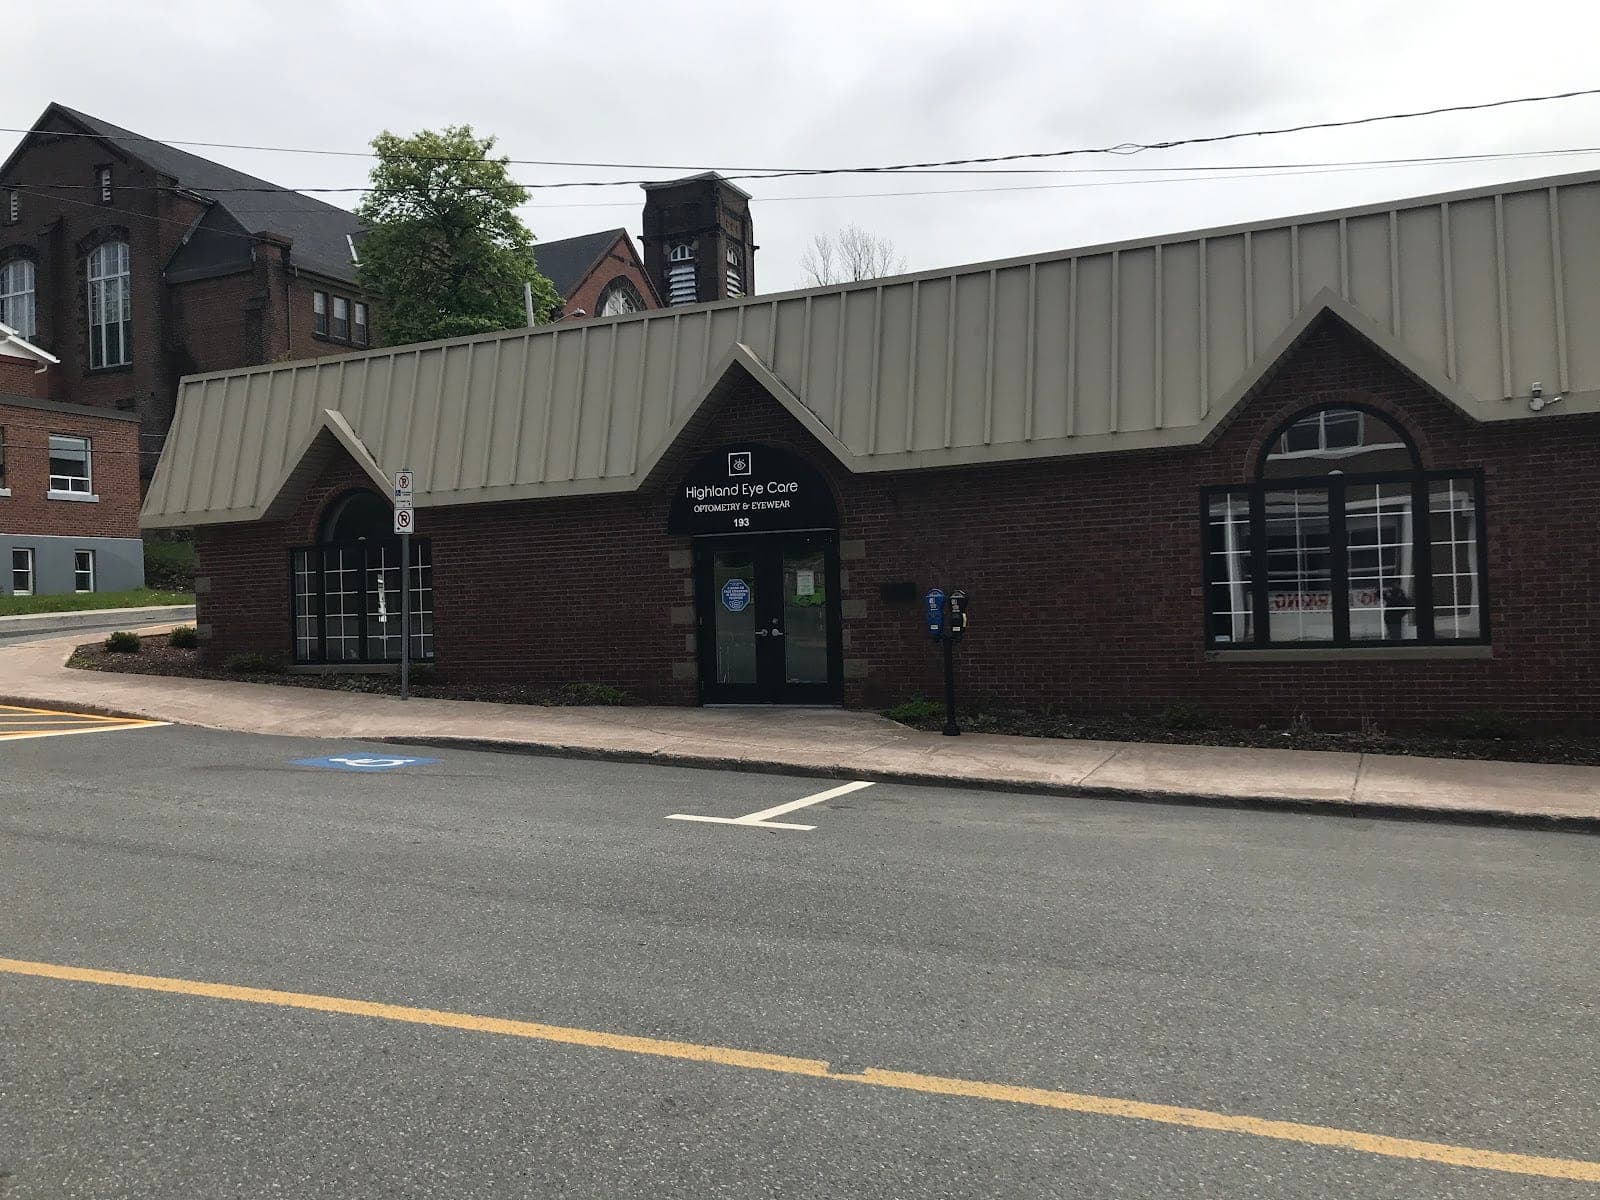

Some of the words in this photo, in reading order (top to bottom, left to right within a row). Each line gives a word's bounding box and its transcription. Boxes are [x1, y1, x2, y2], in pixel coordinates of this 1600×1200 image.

[686, 483, 739, 500] Highland
[742, 483, 764, 497] Eye
[767, 481, 799, 494] Care
[694, 503, 741, 513] OPTOMETRY
[752, 500, 791, 510] EYEWEAR
[733, 517, 750, 527] 193
